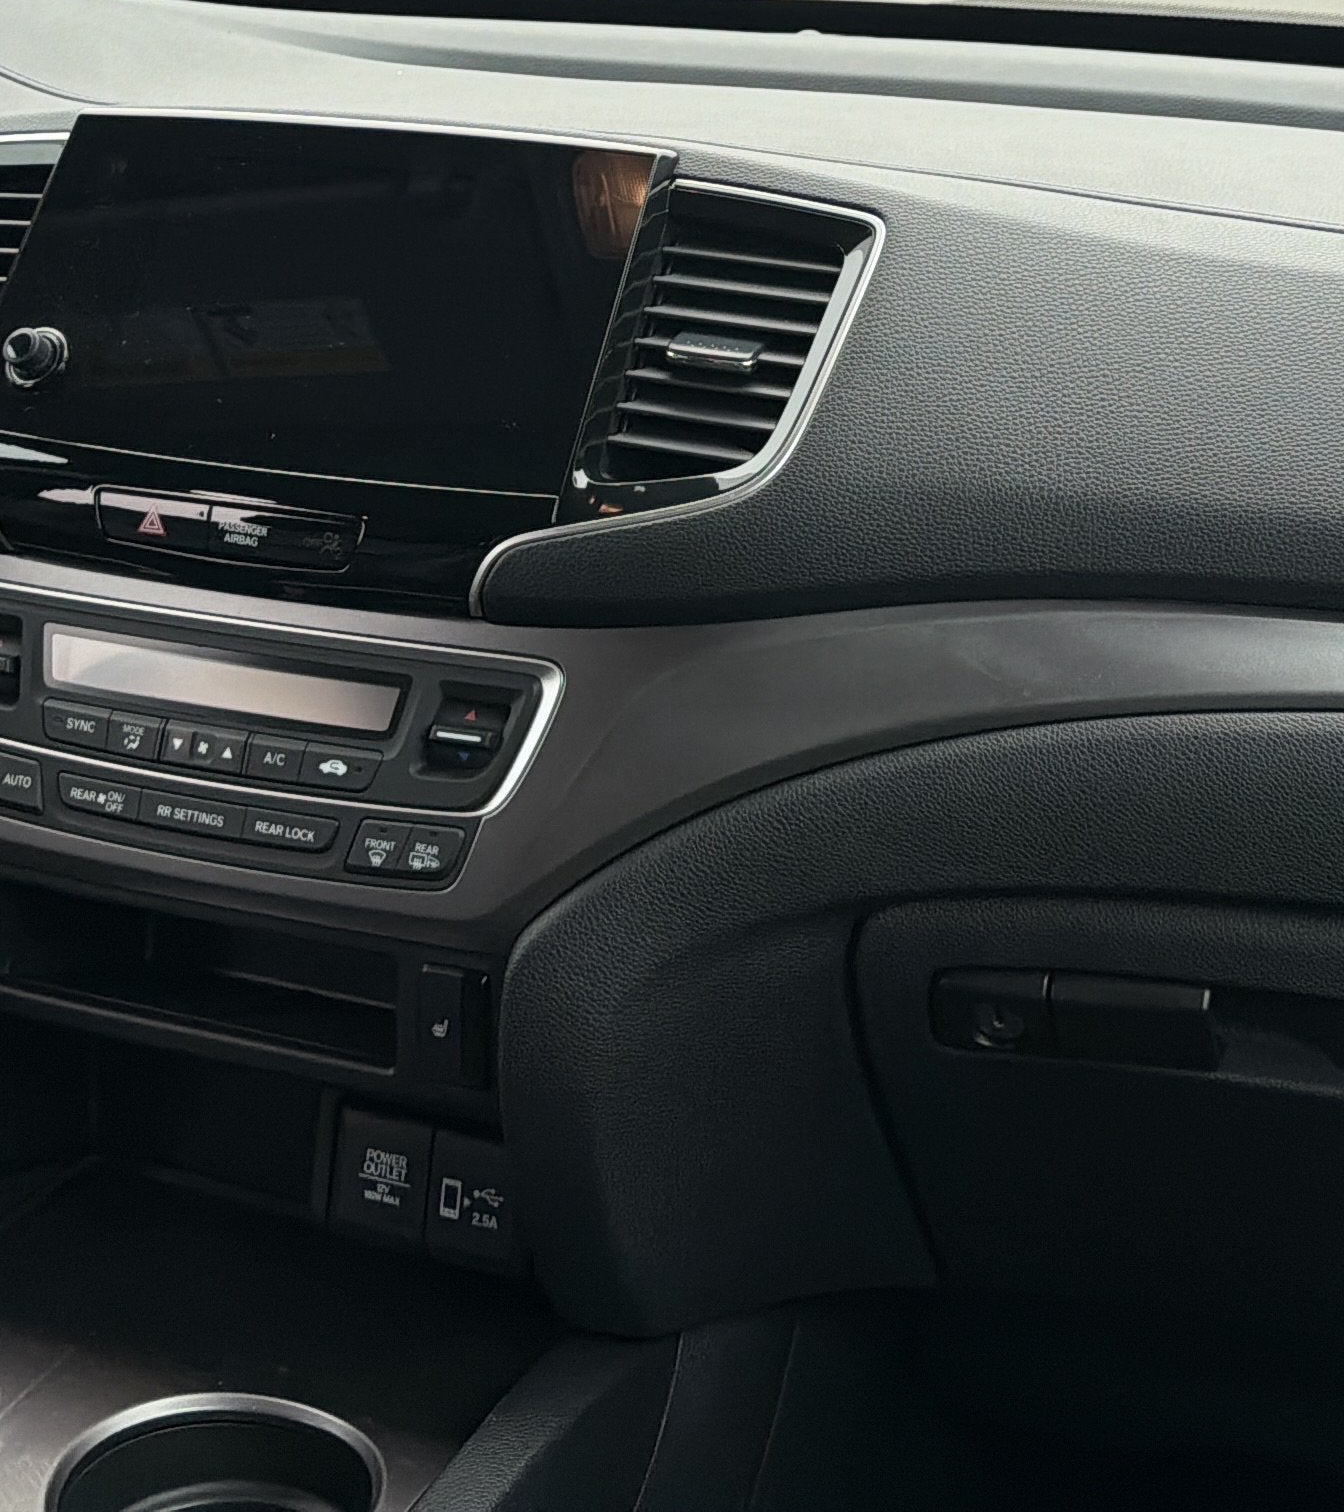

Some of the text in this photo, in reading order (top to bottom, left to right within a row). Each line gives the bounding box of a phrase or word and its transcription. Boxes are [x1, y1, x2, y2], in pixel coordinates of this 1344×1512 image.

[218, 521, 268, 537] PASSENGER
[223, 533, 258, 548] AIRBAG
[66, 717, 96, 733] SYNC
[123, 725, 145, 736] MODE
[263, 751, 286, 767] A/C
[2, 773, 32, 789] AUTO
[69, 787, 126, 802] REAR ON/
[104, 801, 124, 813] OFF
[156, 804, 225, 828] RR SETTINGS
[254, 820, 316, 843] REAR LOCK
[364, 837, 396, 852] FRONT
[414, 841, 440, 855] REAR
[365, 1147, 407, 1169] POWER
[363, 1160, 407, 1182] OUTLET
[471, 1212, 498, 1230] 2.5A
